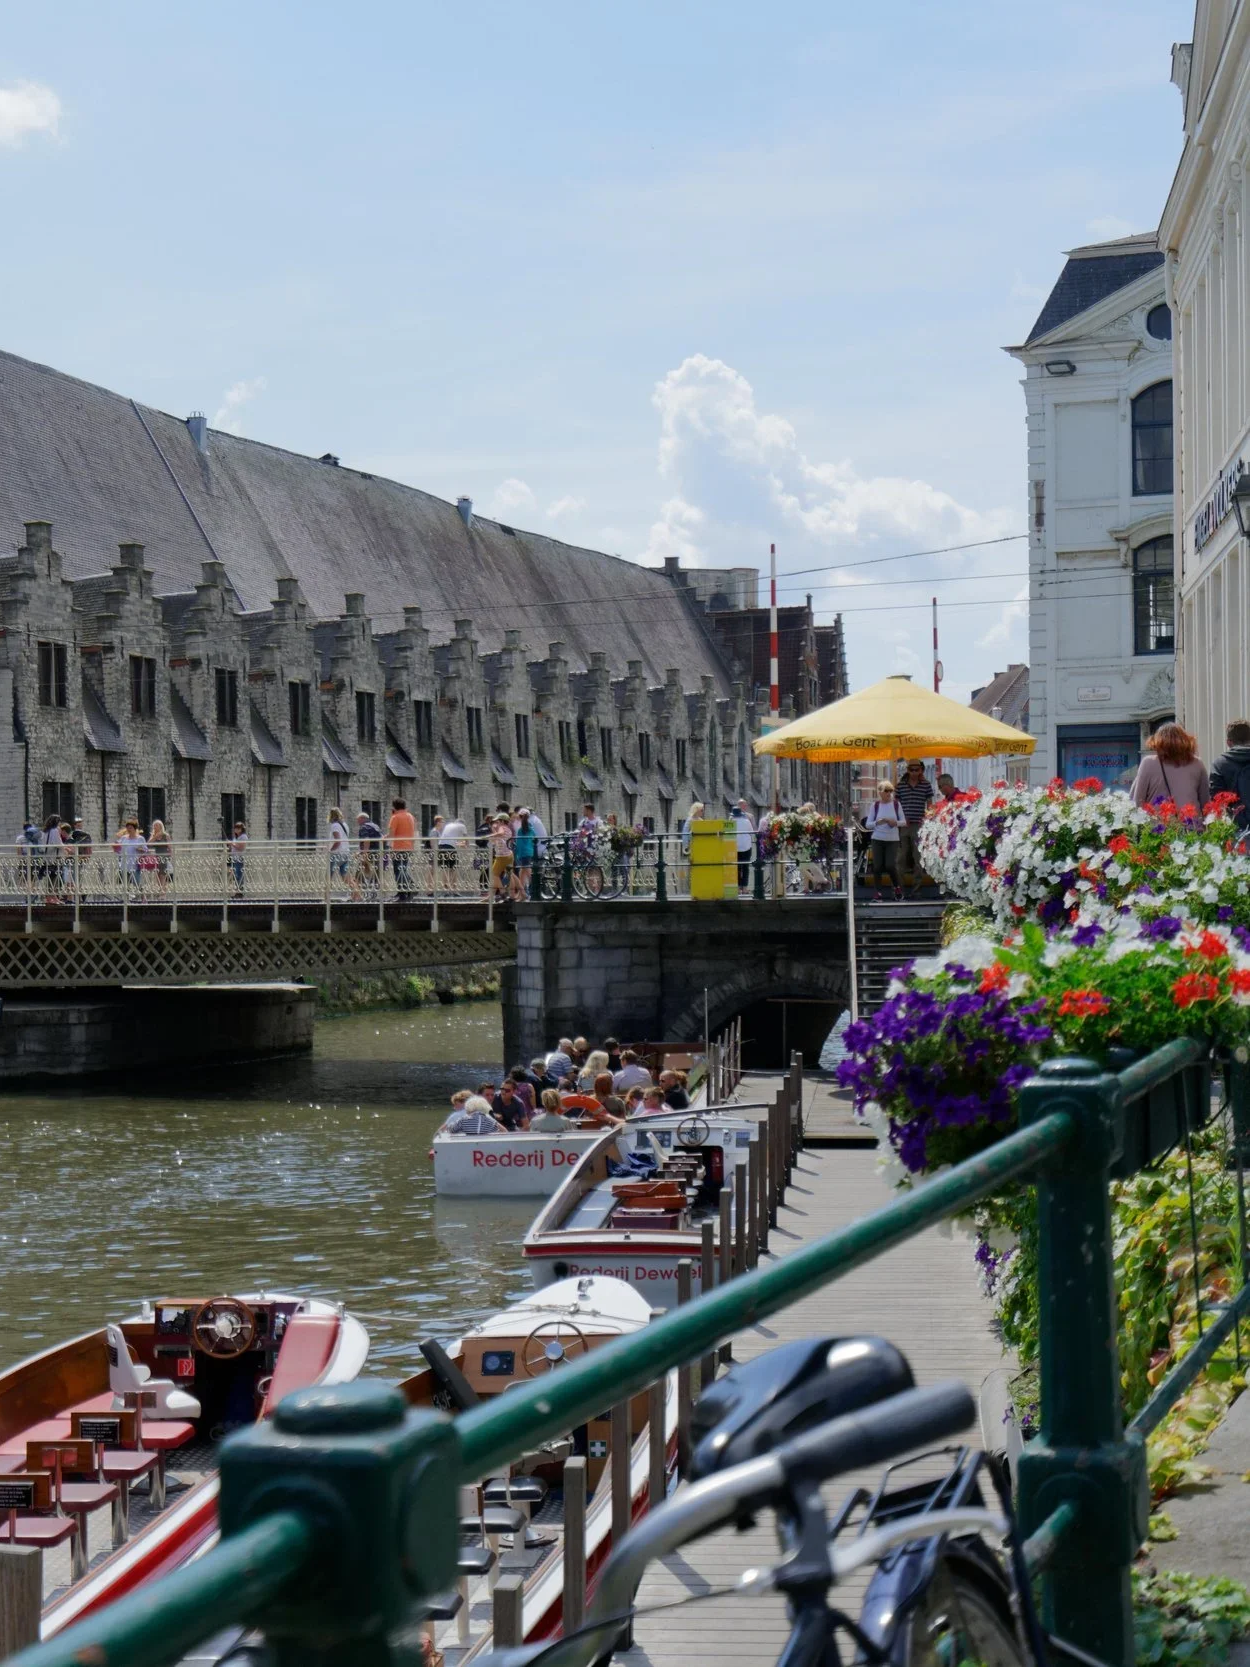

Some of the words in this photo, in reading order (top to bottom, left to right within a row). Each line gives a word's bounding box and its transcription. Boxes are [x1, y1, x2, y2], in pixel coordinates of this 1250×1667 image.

[795, 738, 822, 751] Boat
[825, 738, 838, 747] in
[843, 736, 878, 749] Gent
[472, 1149, 545, 1169] Rederij
[551, 1149, 580, 1166] De
[635, 1265, 702, 1281] Dewel
